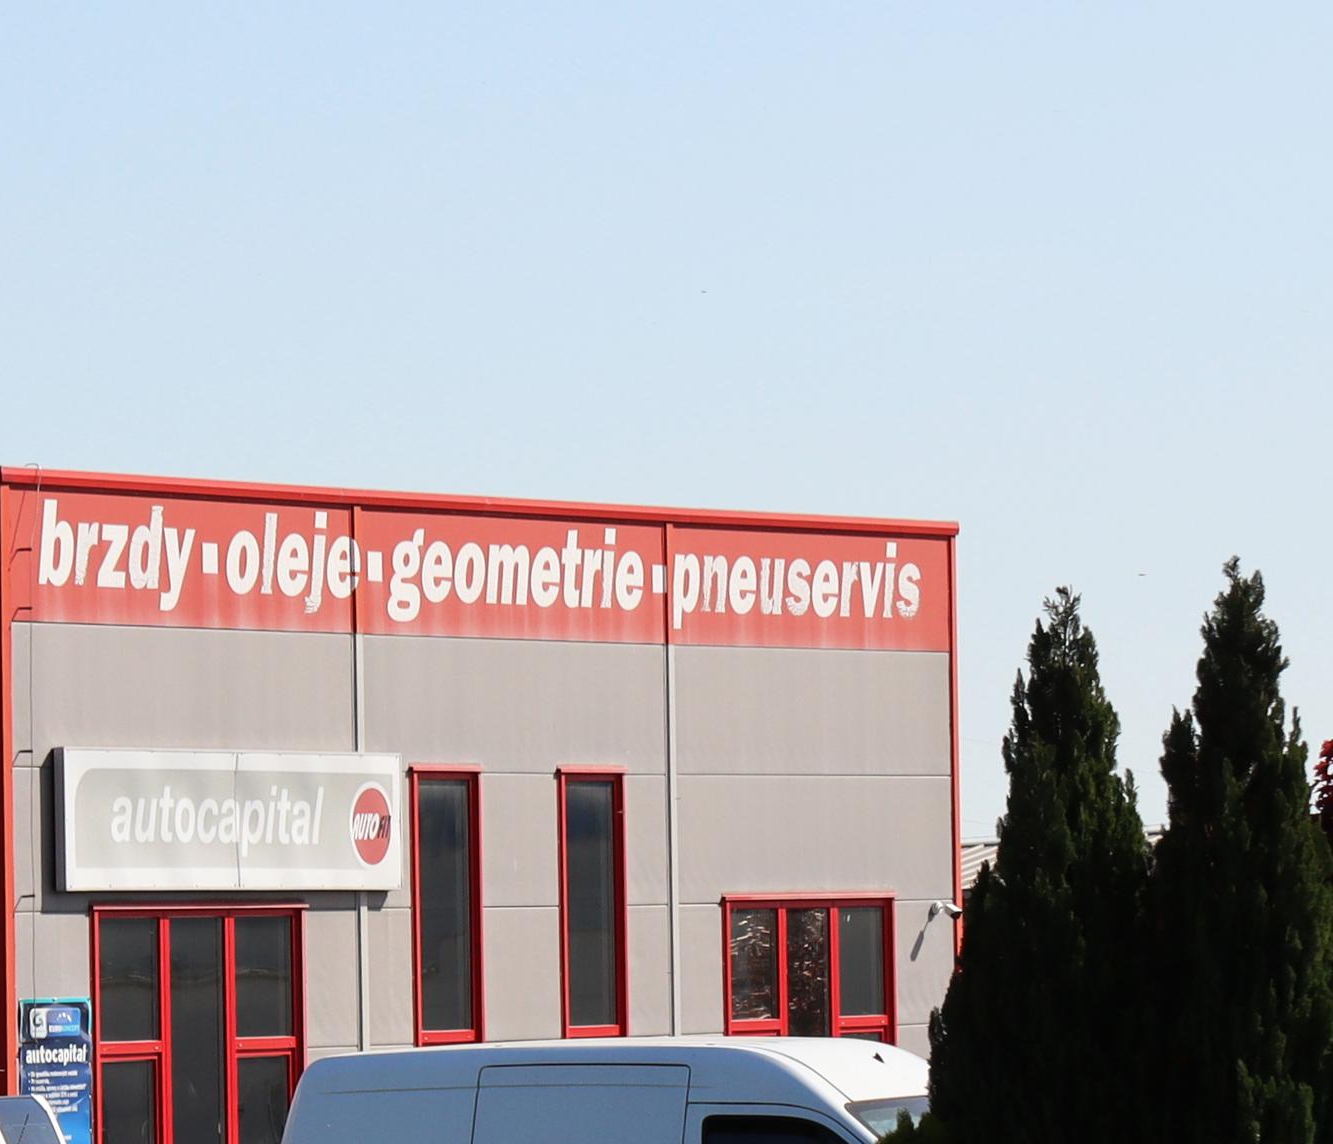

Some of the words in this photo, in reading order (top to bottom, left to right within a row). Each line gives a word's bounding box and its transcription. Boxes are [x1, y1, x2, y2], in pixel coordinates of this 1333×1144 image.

[39, 498, 196, 611] brzdy
[227, 512, 361, 614] oleje
[389, 527, 644, 623] geometrie
[674, 541, 921, 630] pneuservis
[110, 784, 324, 858] autocapital
[26, 1043, 87, 1066] autocapital
